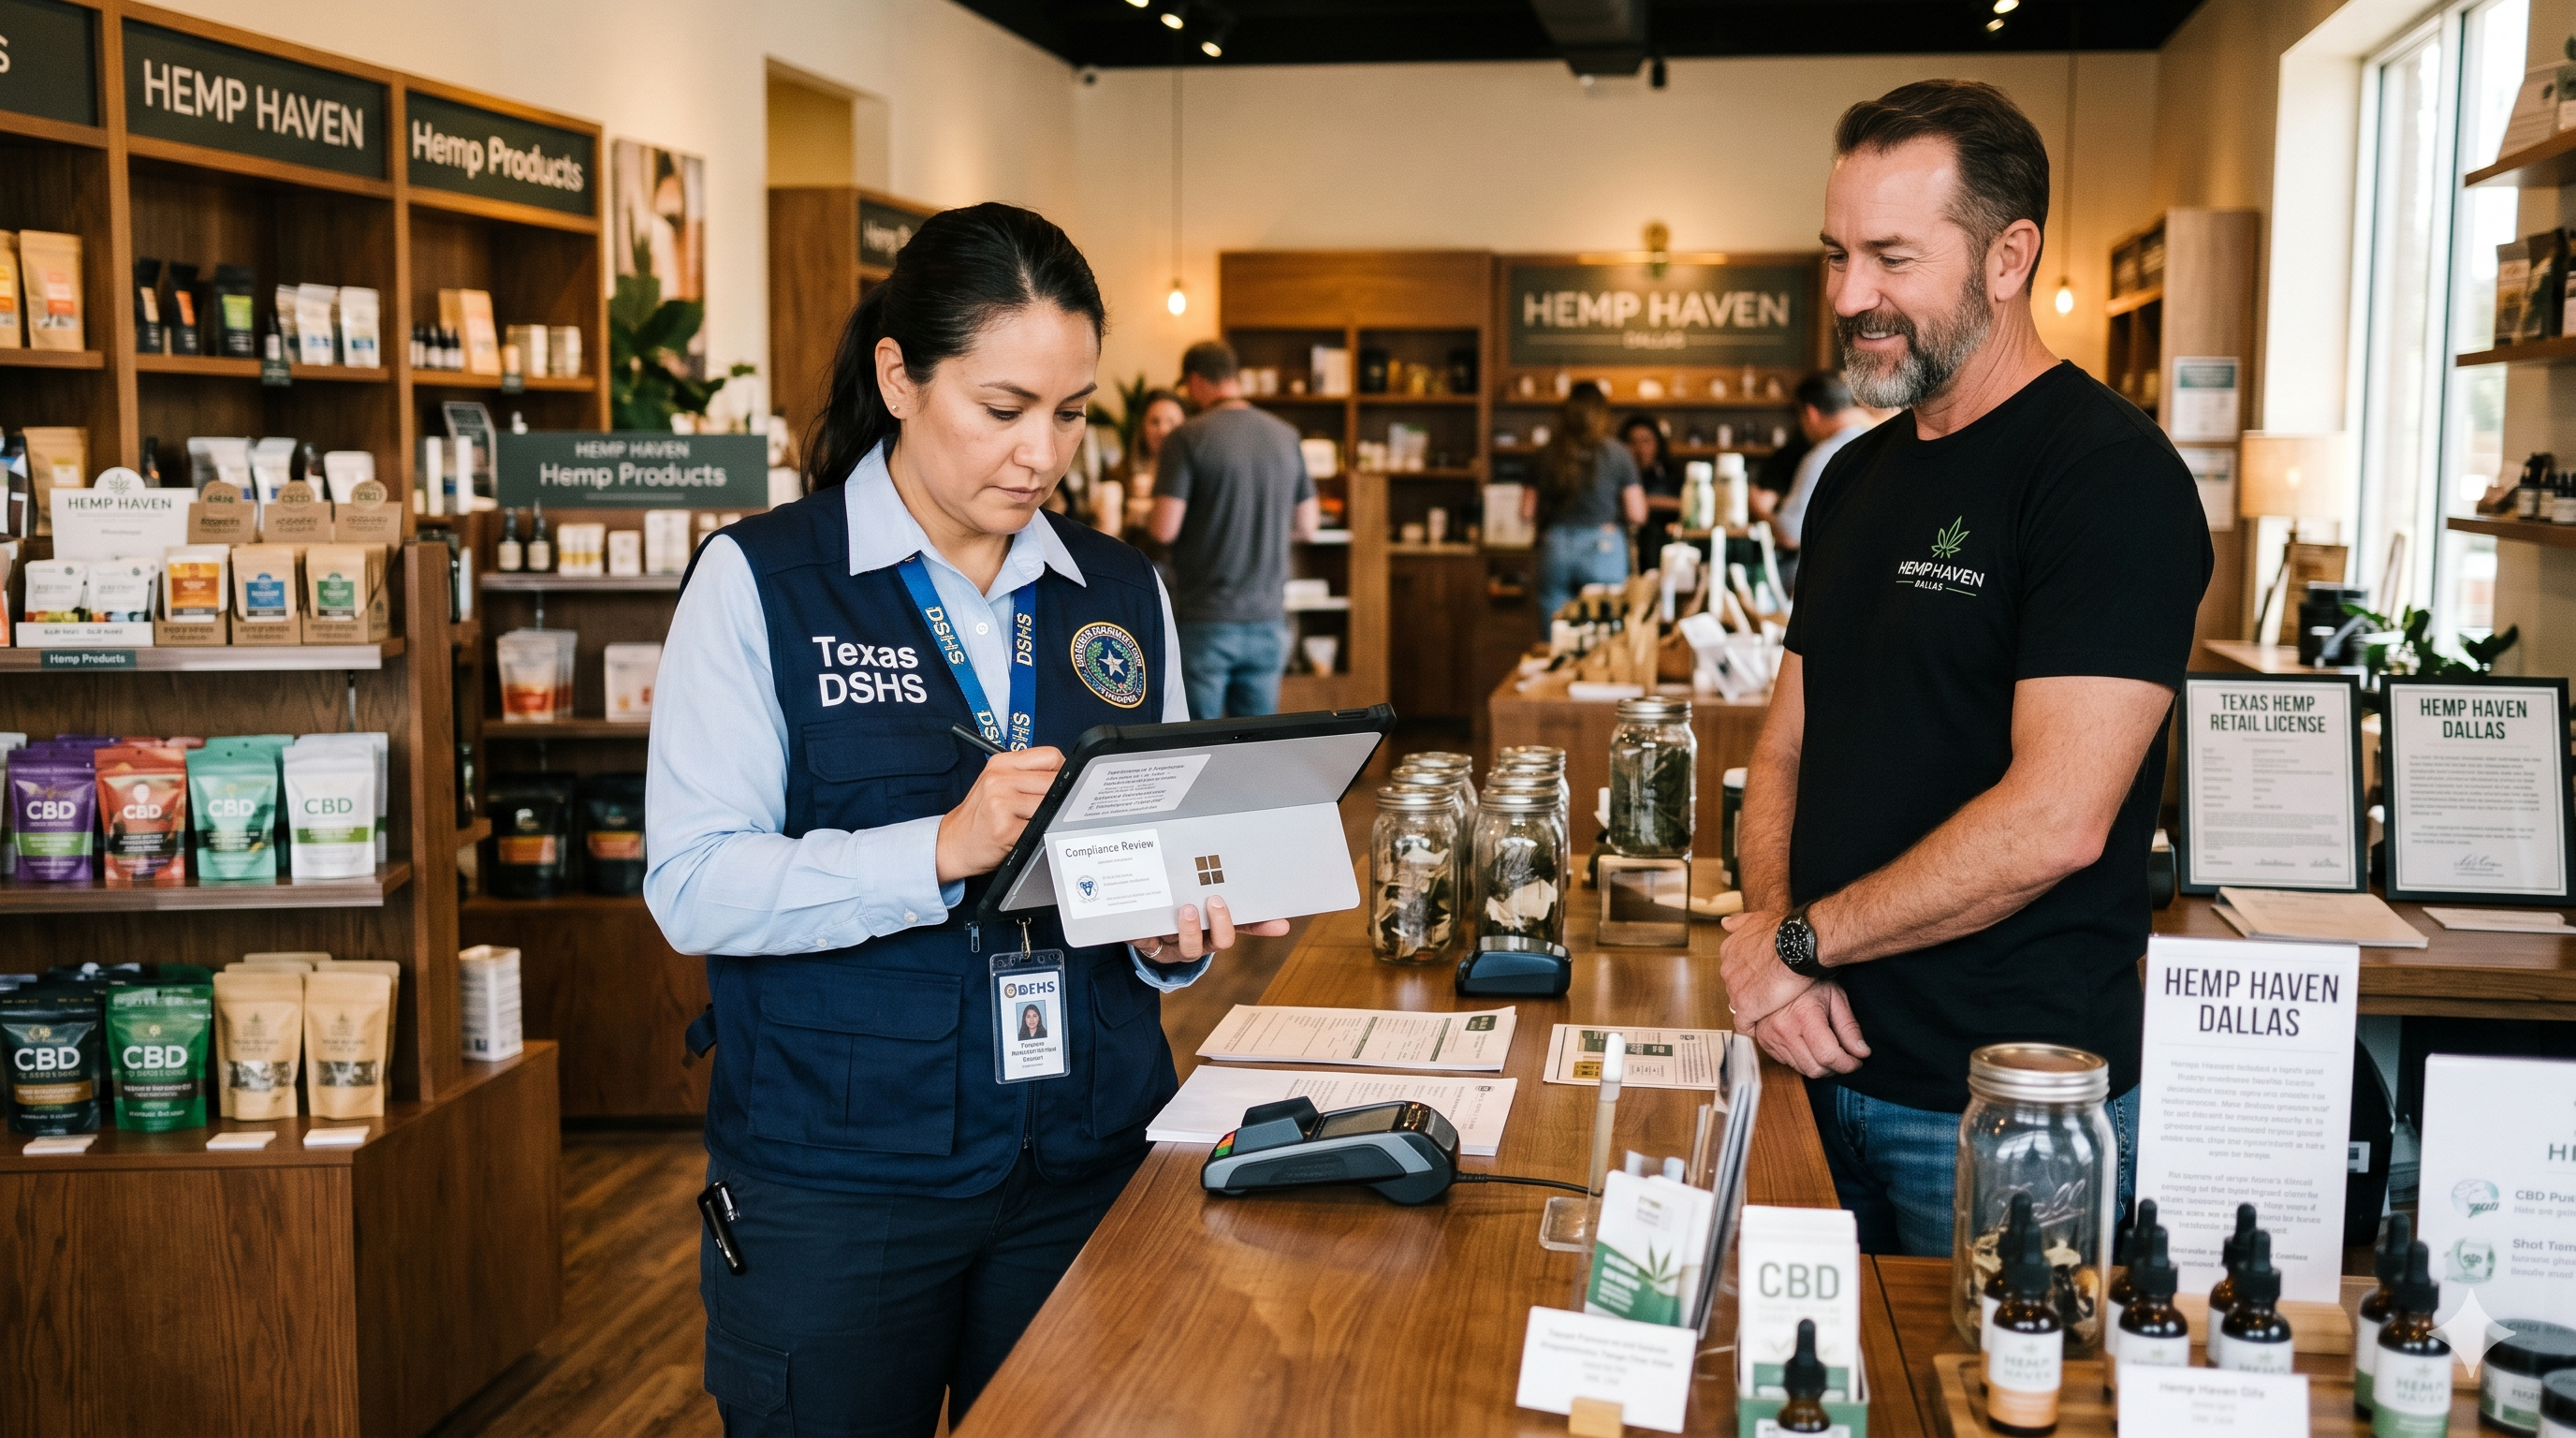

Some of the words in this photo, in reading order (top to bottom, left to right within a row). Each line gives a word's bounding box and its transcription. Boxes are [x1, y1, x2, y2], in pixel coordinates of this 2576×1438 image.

[144, 59, 247, 124] HEMP
[256, 86, 364, 150] HAVEN
[412, 120, 484, 178] Hemp
[489, 136, 584, 193] Products
[1524, 291, 1641, 328] HEMP
[1648, 291, 1790, 328] HAVEN
[576, 441, 624, 458] HEMP
[630, 441, 691, 459] HAVEN
[540, 462, 613, 489] Hemp
[619, 462, 727, 487] Products
[68, 497, 112, 509] HEMP
[118, 497, 172, 509] HAVEN
[1898, 562, 1933, 576] HEMP
[1930, 564, 1984, 588] HAVEN
[925, 606, 965, 666] DSHS
[1016, 612, 1033, 667] DSHS
[50, 654, 80, 665] Hemp
[812, 636, 918, 669] Texas
[818, 671, 928, 707] DSHS
[2220, 694, 2268, 712] TEXAS
[2273, 695, 2315, 712] HEMP
[2421, 698, 2467, 718] HEMP
[2473, 699, 2527, 718] HAVEN
[2211, 714, 2261, 732] RETAIL
[2265, 715, 2326, 733] LICENSE
[2443, 720, 2506, 740] DALLAS
[26, 800, 77, 821] CBD
[123, 803, 163, 820] CBD
[208, 799, 256, 818] CBD
[304, 798, 353, 814] CBD
[1065, 844, 1119, 858] Compliance
[1121, 840, 1154, 851] Review
[2165, 967, 2240, 998] HEMP
[2250, 971, 2339, 1003] HAVEN
[2200, 1004, 2300, 1036] DALLAS
[14, 1047, 80, 1071] CBD
[123, 1046, 187, 1069] CBD
[2548, 1143, 2576, 1161] H
[2515, 1190, 2545, 1201] CBD
[2512, 1239, 2543, 1250] Shot
[1759, 1261, 1840, 1300] CBD
